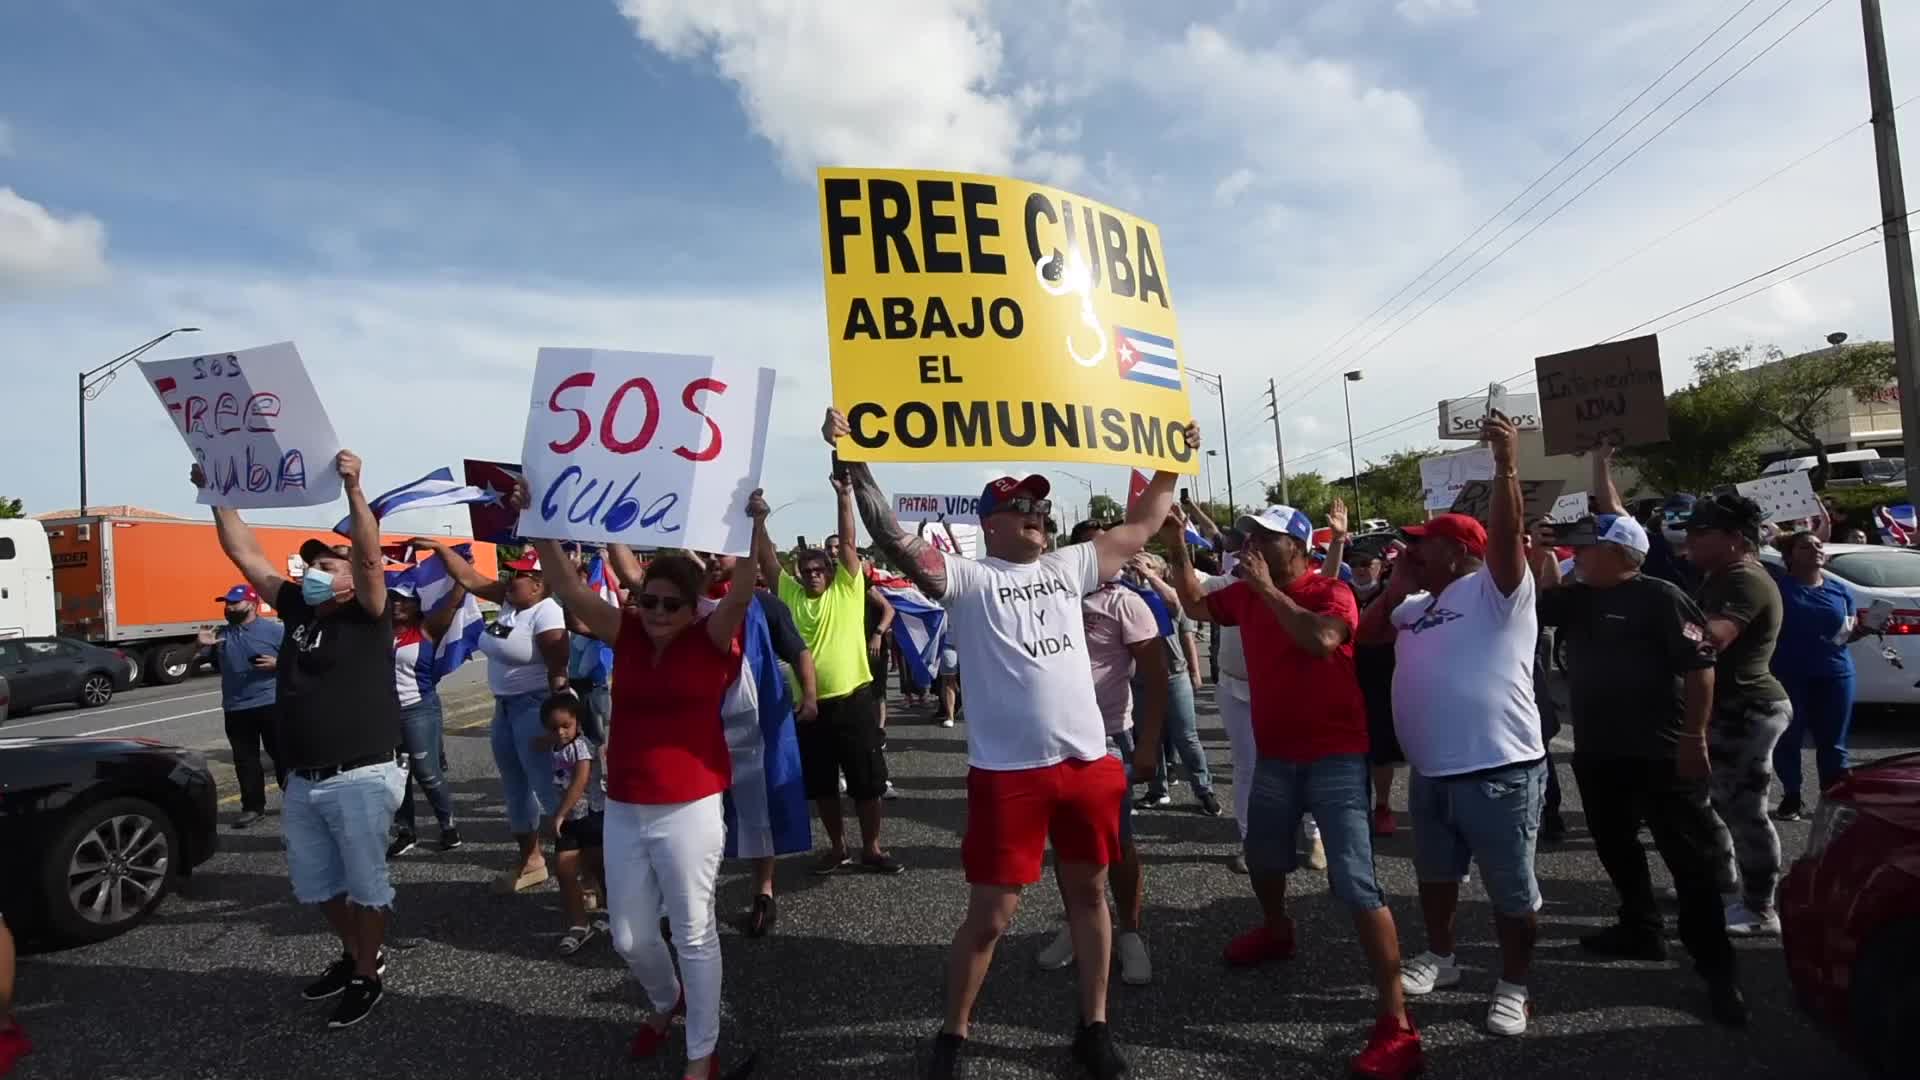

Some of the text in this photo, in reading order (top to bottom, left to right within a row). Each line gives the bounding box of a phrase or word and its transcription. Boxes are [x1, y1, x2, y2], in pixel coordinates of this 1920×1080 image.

[824, 178, 1169, 309] FREE CUBA
[843, 297, 1024, 341] ABAJO
[193, 354, 242, 380] SOS
[918, 355, 963, 384] EL
[847, 400, 1192, 463] COMUNISMO
[1453, 413, 1535, 430] Sedo's
[541, 465, 681, 533] Cuba
[898, 495, 938, 513] PATRIA
[945, 496, 979, 515] VIDA
[999, 578, 1067, 604] PATRIA
[1034, 609, 1046, 626] Y
[1023, 633, 1075, 658] VIDA
